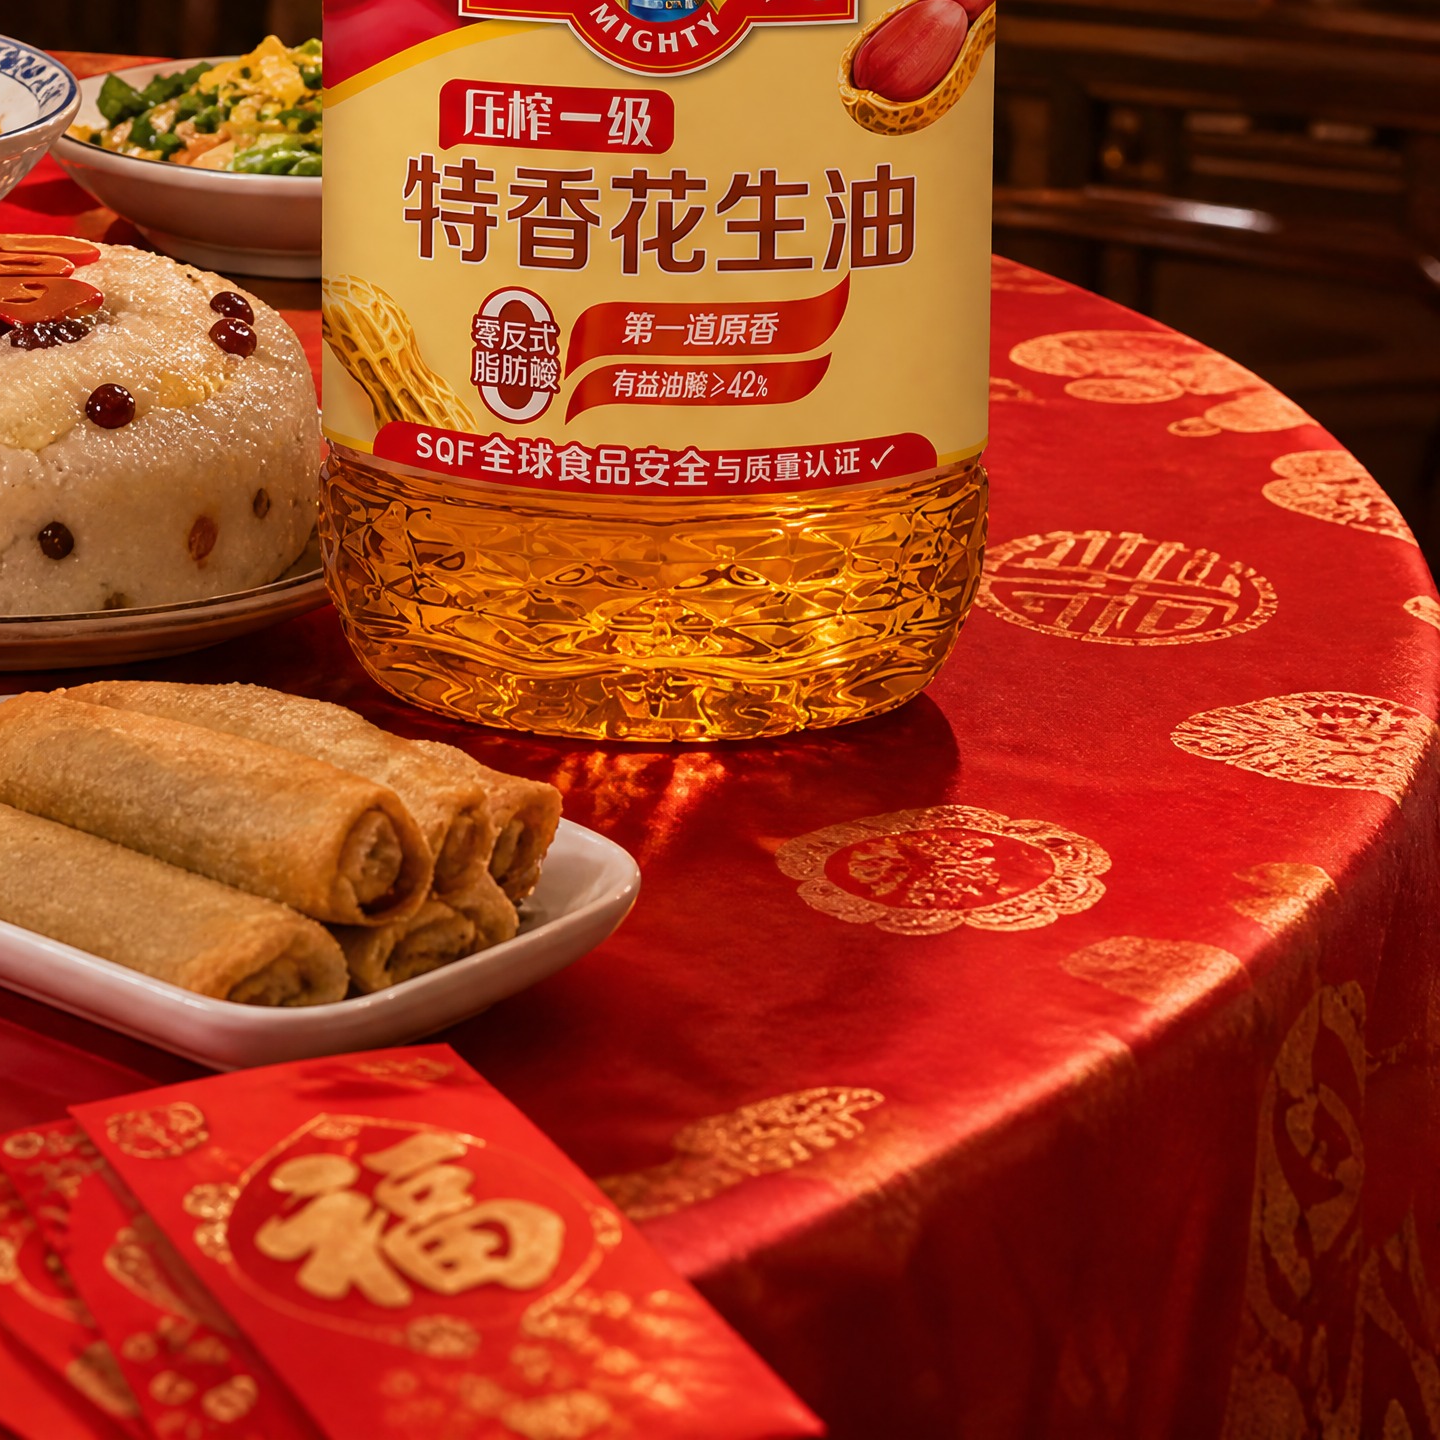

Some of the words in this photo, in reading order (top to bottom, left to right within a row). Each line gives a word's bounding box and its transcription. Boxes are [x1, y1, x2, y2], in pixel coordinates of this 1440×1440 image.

[589, 2, 721, 54] MIGHTY
[463, 89, 654, 148] 压榨一级
[402, 153, 917, 275] 特香花生油
[475, 318, 557, 356] 零反式
[621, 311, 780, 346] 第一道原香
[256, 1132, 566, 1308] 福
